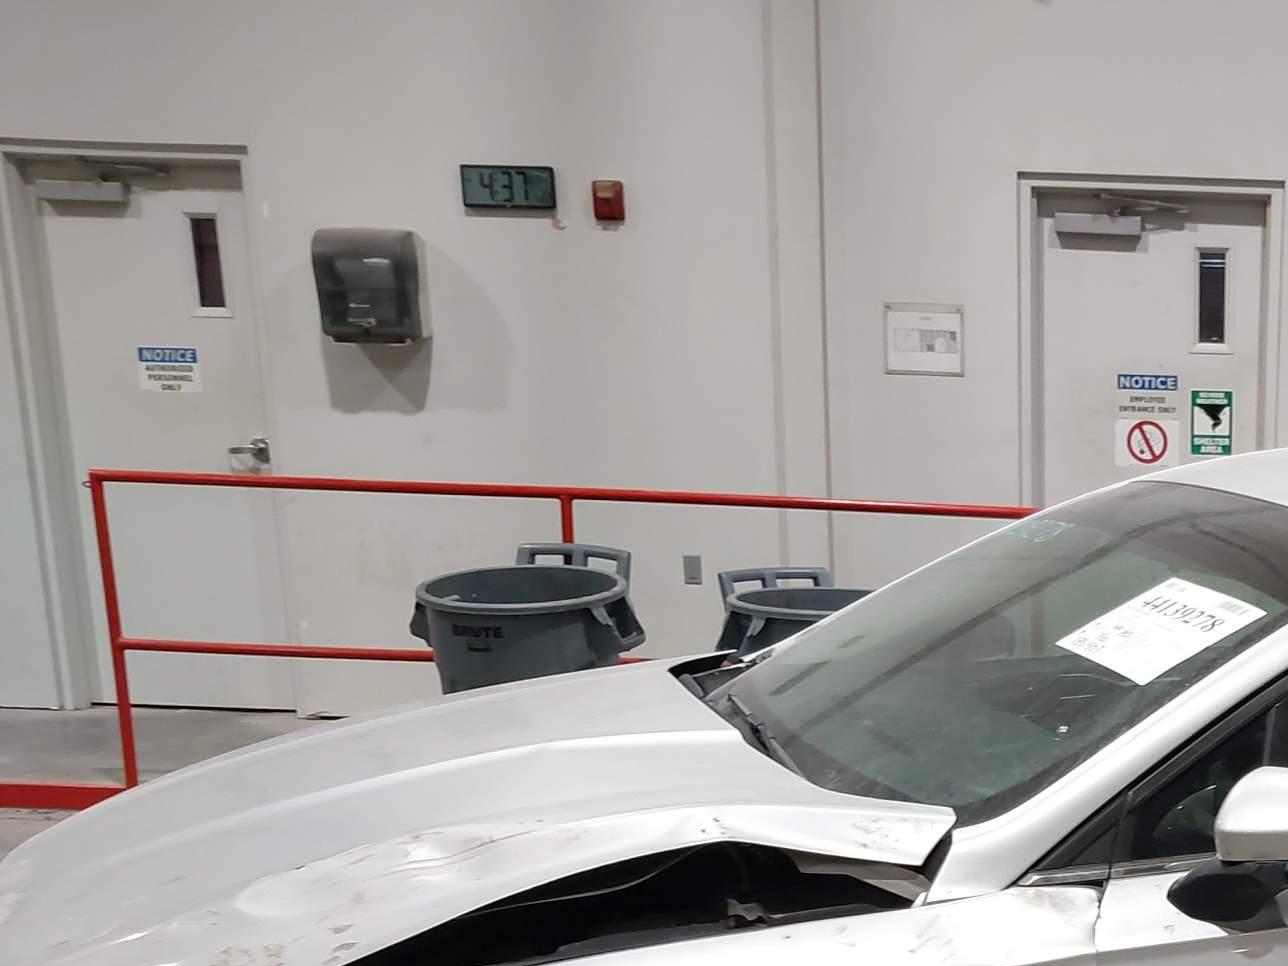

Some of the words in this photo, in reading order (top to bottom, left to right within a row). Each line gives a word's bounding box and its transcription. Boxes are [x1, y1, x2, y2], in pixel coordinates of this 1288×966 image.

[142, 349, 195, 362] NOTICE
[1119, 376, 1177, 389] NOTICE
[1143, 596, 1225, 632] 44139278
